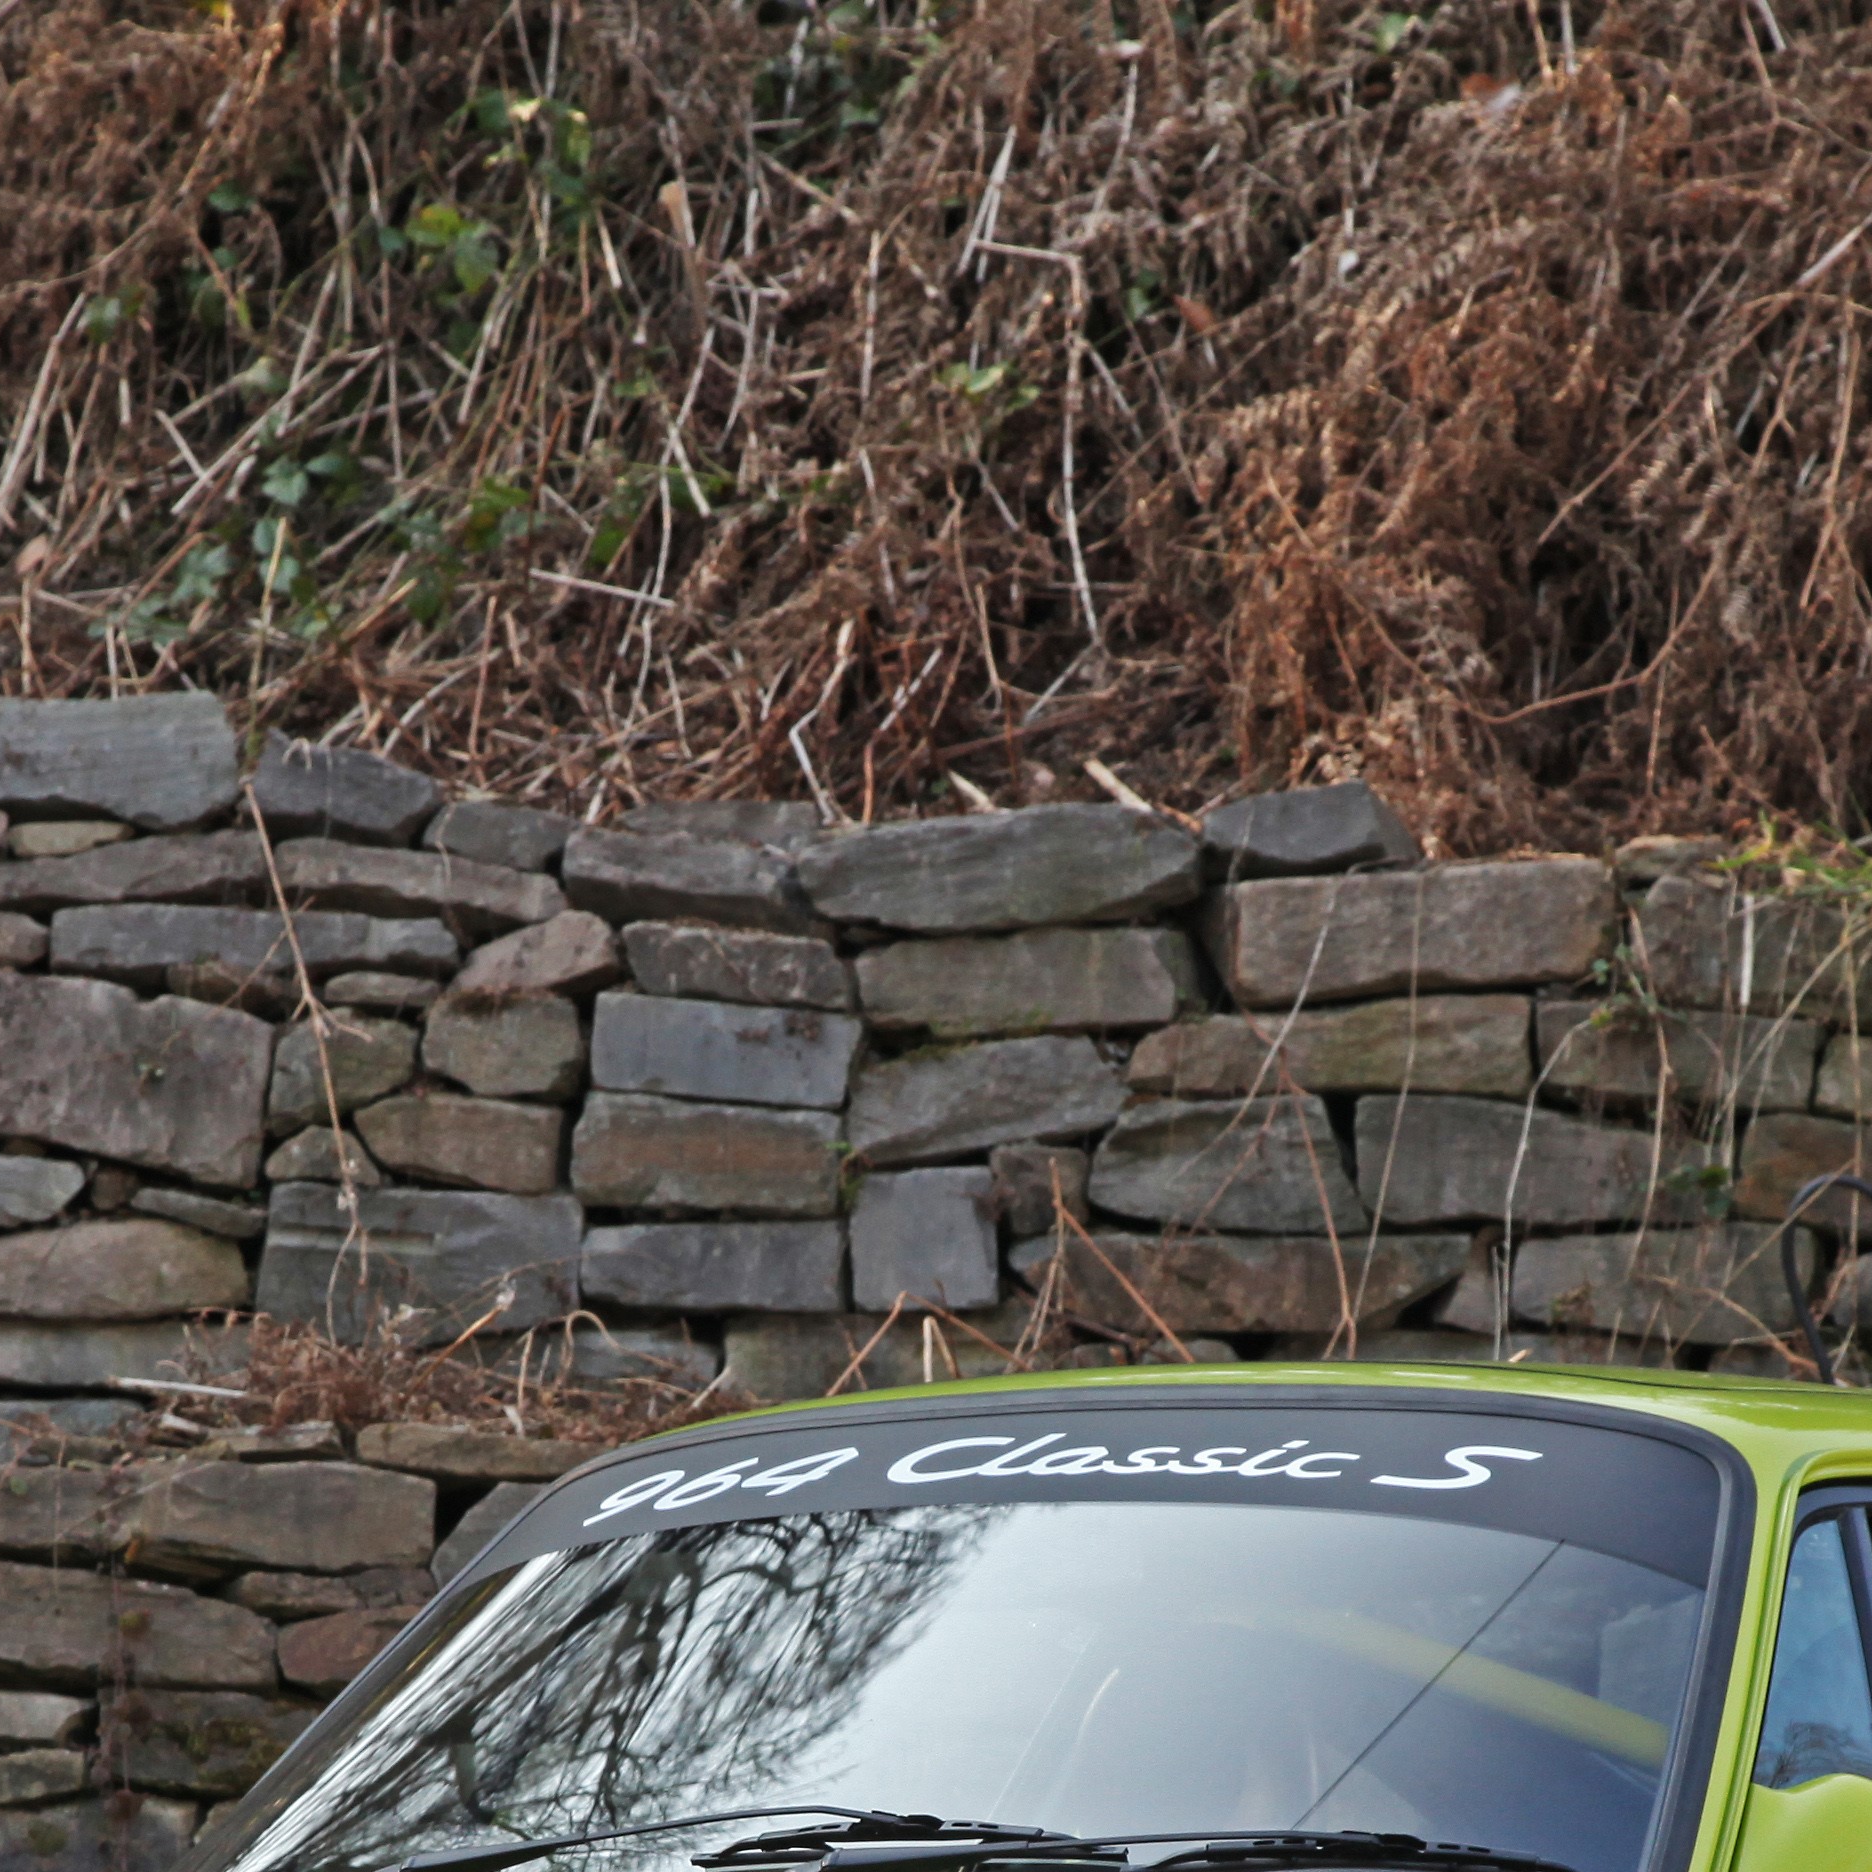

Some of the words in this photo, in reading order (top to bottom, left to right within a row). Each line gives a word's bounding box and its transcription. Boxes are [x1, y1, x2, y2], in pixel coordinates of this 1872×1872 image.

[583, 1445, 860, 1527] 964
[885, 1431, 1360, 1486] Classic
[1369, 1444, 1544, 1490] S
